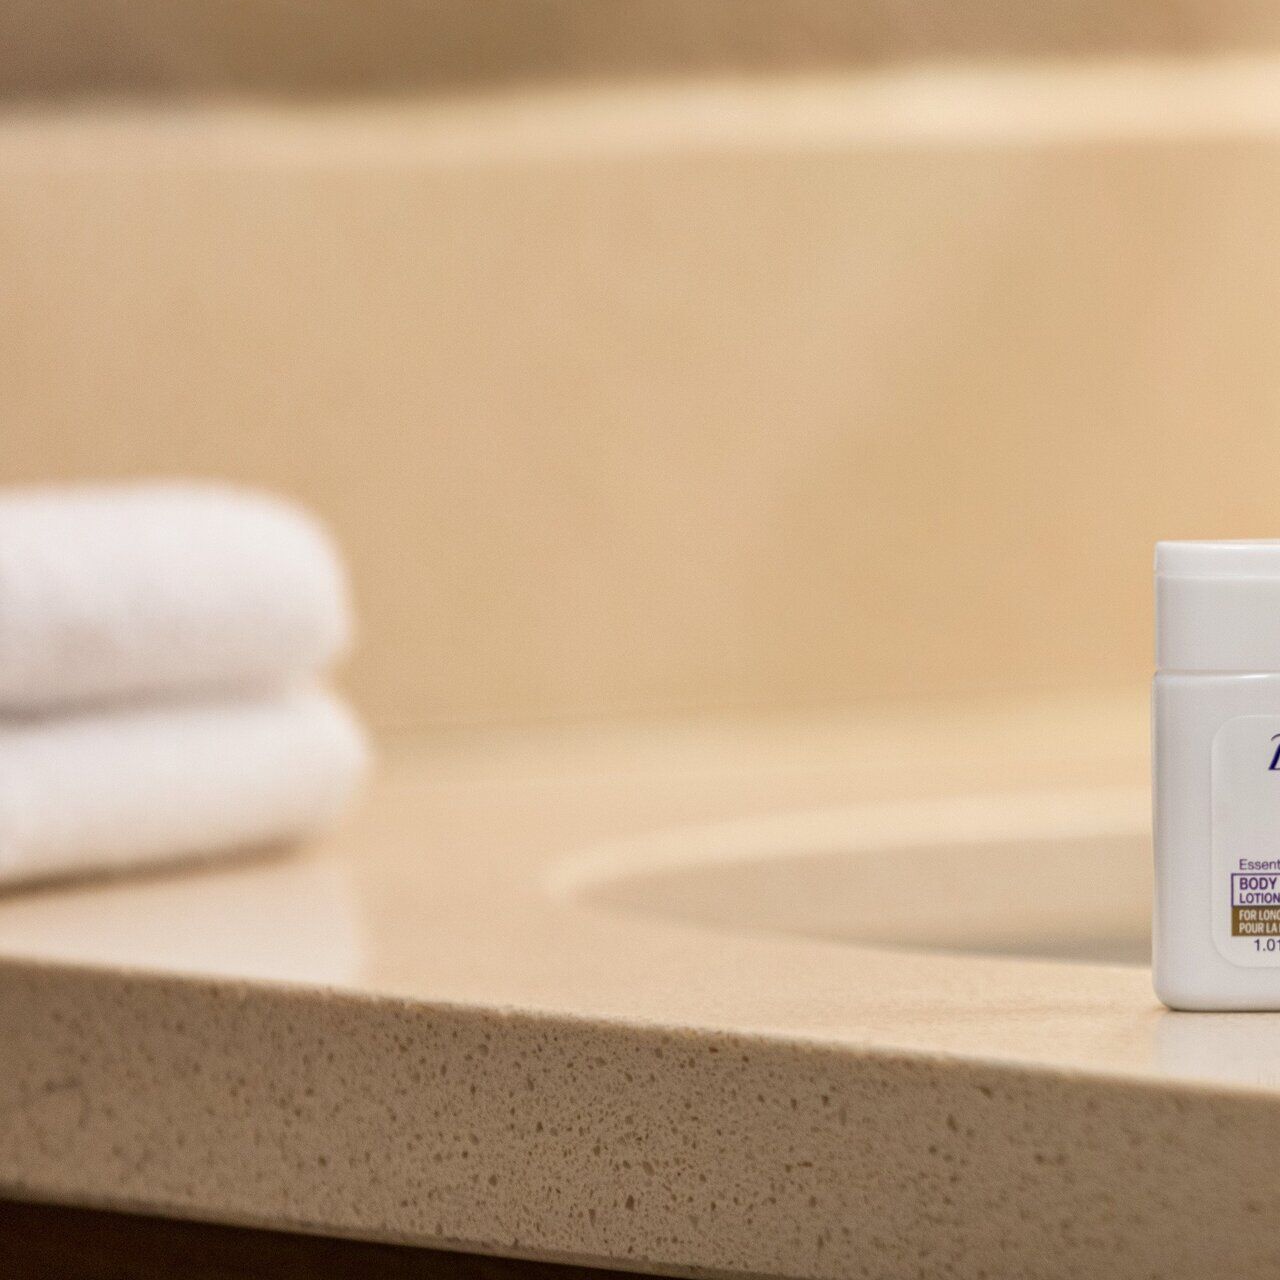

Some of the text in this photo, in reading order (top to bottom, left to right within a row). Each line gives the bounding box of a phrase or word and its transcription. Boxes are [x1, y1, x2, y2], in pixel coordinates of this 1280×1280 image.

[1239, 877, 1277, 890] BODY
[1239, 892, 1280, 904] LOTION
[1239, 909, 1257, 920] FOR
[1239, 922, 1264, 933] POUR
[1266, 922, 1278, 933] LA
